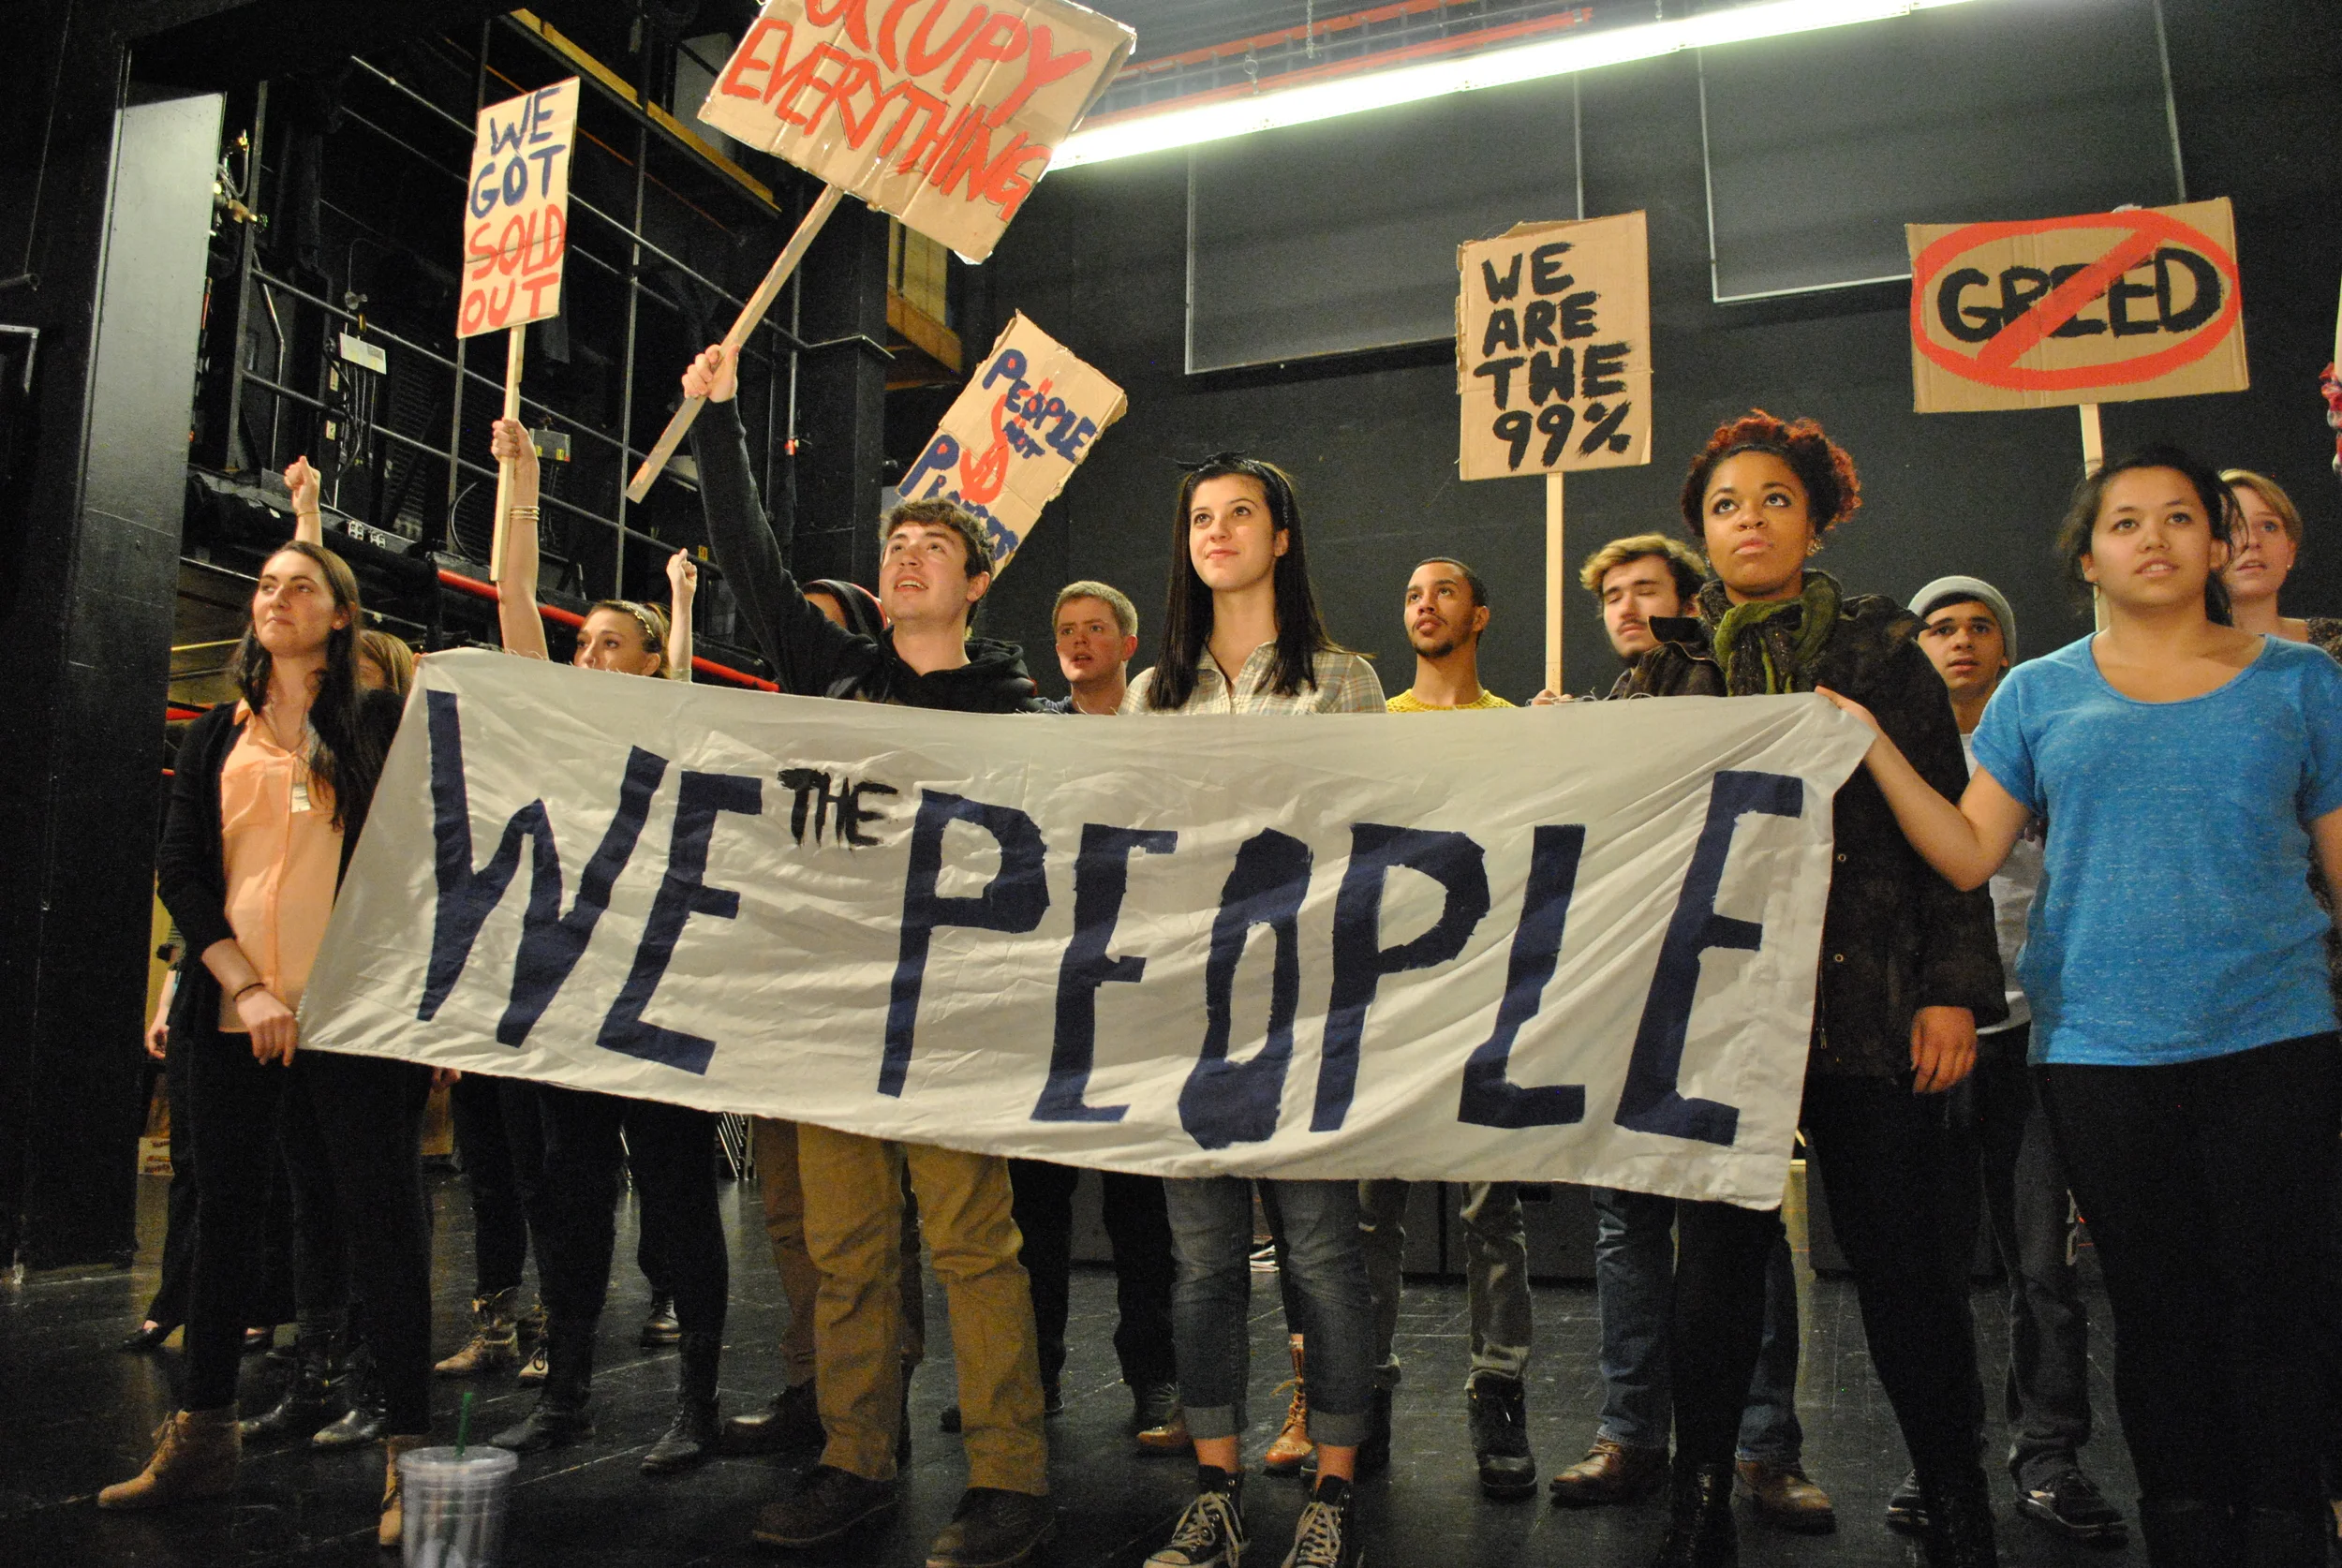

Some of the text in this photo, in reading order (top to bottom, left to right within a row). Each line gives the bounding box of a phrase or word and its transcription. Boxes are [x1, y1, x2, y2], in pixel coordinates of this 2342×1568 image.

[489, 86, 562, 155] WE
[720, 17, 1054, 222] EVERYTHING
[469, 144, 566, 219] GOT
[468, 203, 567, 281] SOLD
[1481, 242, 1575, 304] WE
[461, 272, 559, 334] OUT
[1481, 290, 1601, 358] ARE
[1937, 246, 2226, 343] GREED
[982, 348, 1097, 464] PEOPLE
[1473, 340, 1632, 410] THE
[1492, 400, 1632, 471] 99%
[416, 688, 1803, 1149] WE THE PEOPLE
